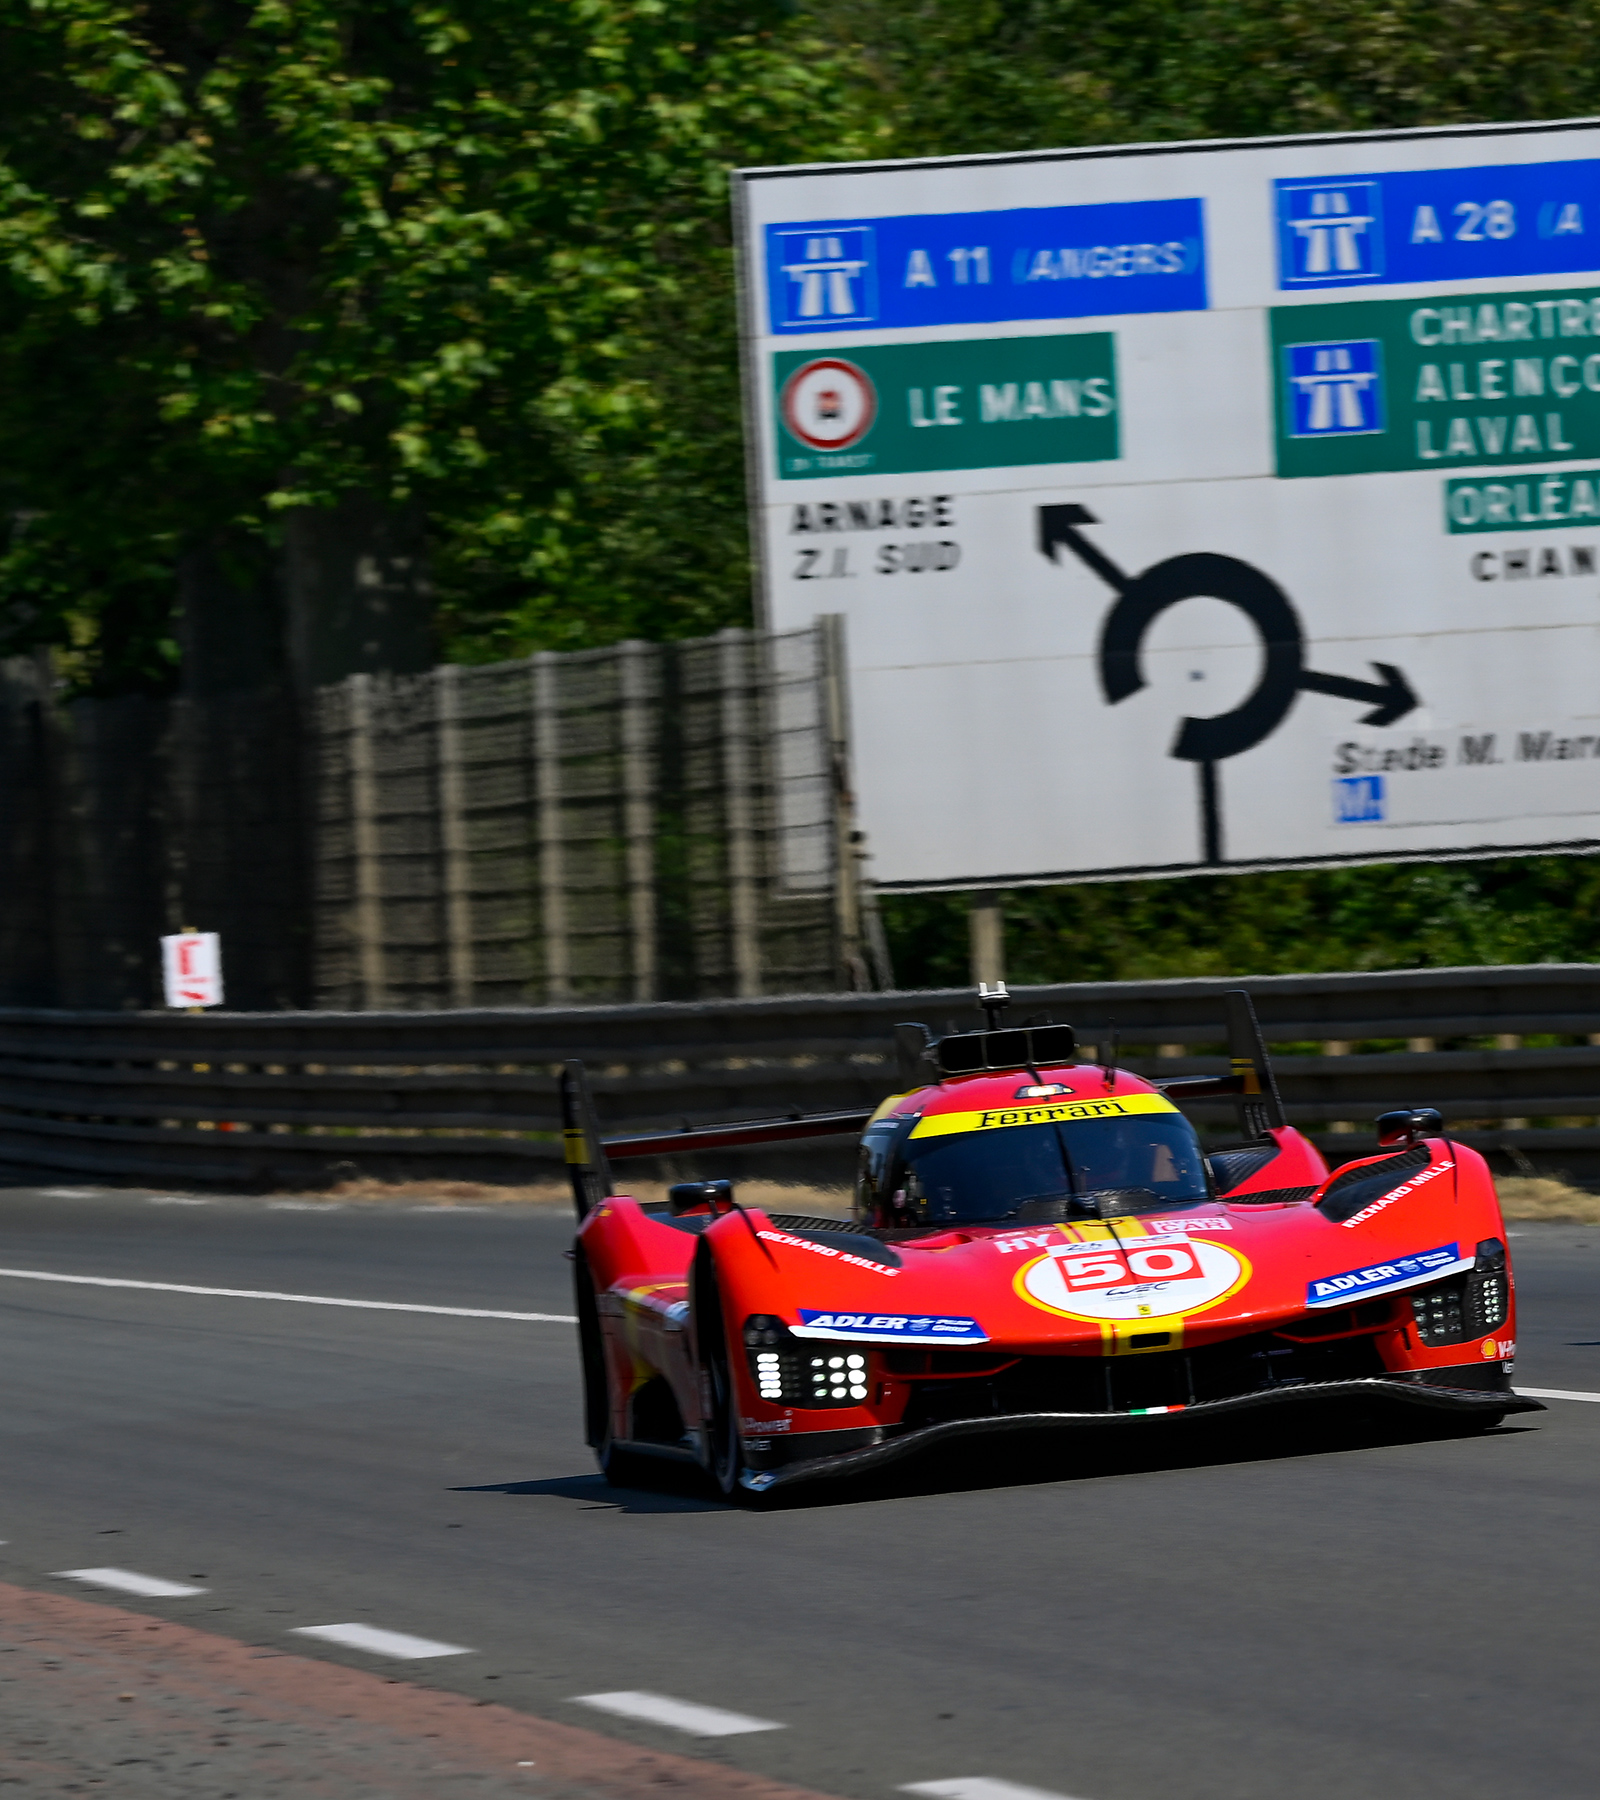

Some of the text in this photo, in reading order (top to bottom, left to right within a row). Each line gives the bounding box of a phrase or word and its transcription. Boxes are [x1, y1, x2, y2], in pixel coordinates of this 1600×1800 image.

[1410, 204, 1444, 244] A
[1453, 199, 1517, 242] 28
[904, 249, 937, 288] A
[947, 246, 991, 285] 11
[908, 378, 1115, 428] LE MANS
[1415, 412, 1575, 460] LAVAL
[789, 494, 957, 536] ARNAGE
[874, 541, 962, 575] SUD
[974, 1099, 1129, 1129] Ferrari
[1341, 1160, 1456, 1228] RICHARD MILLE
[756, 1230, 901, 1277] RICHARD MILLE
[994, 1234, 1049, 1254] HY
[1062, 1248, 1194, 1287] 50
[1313, 1264, 1403, 1297] ADLER
[805, 1314, 910, 1330] ADLER
